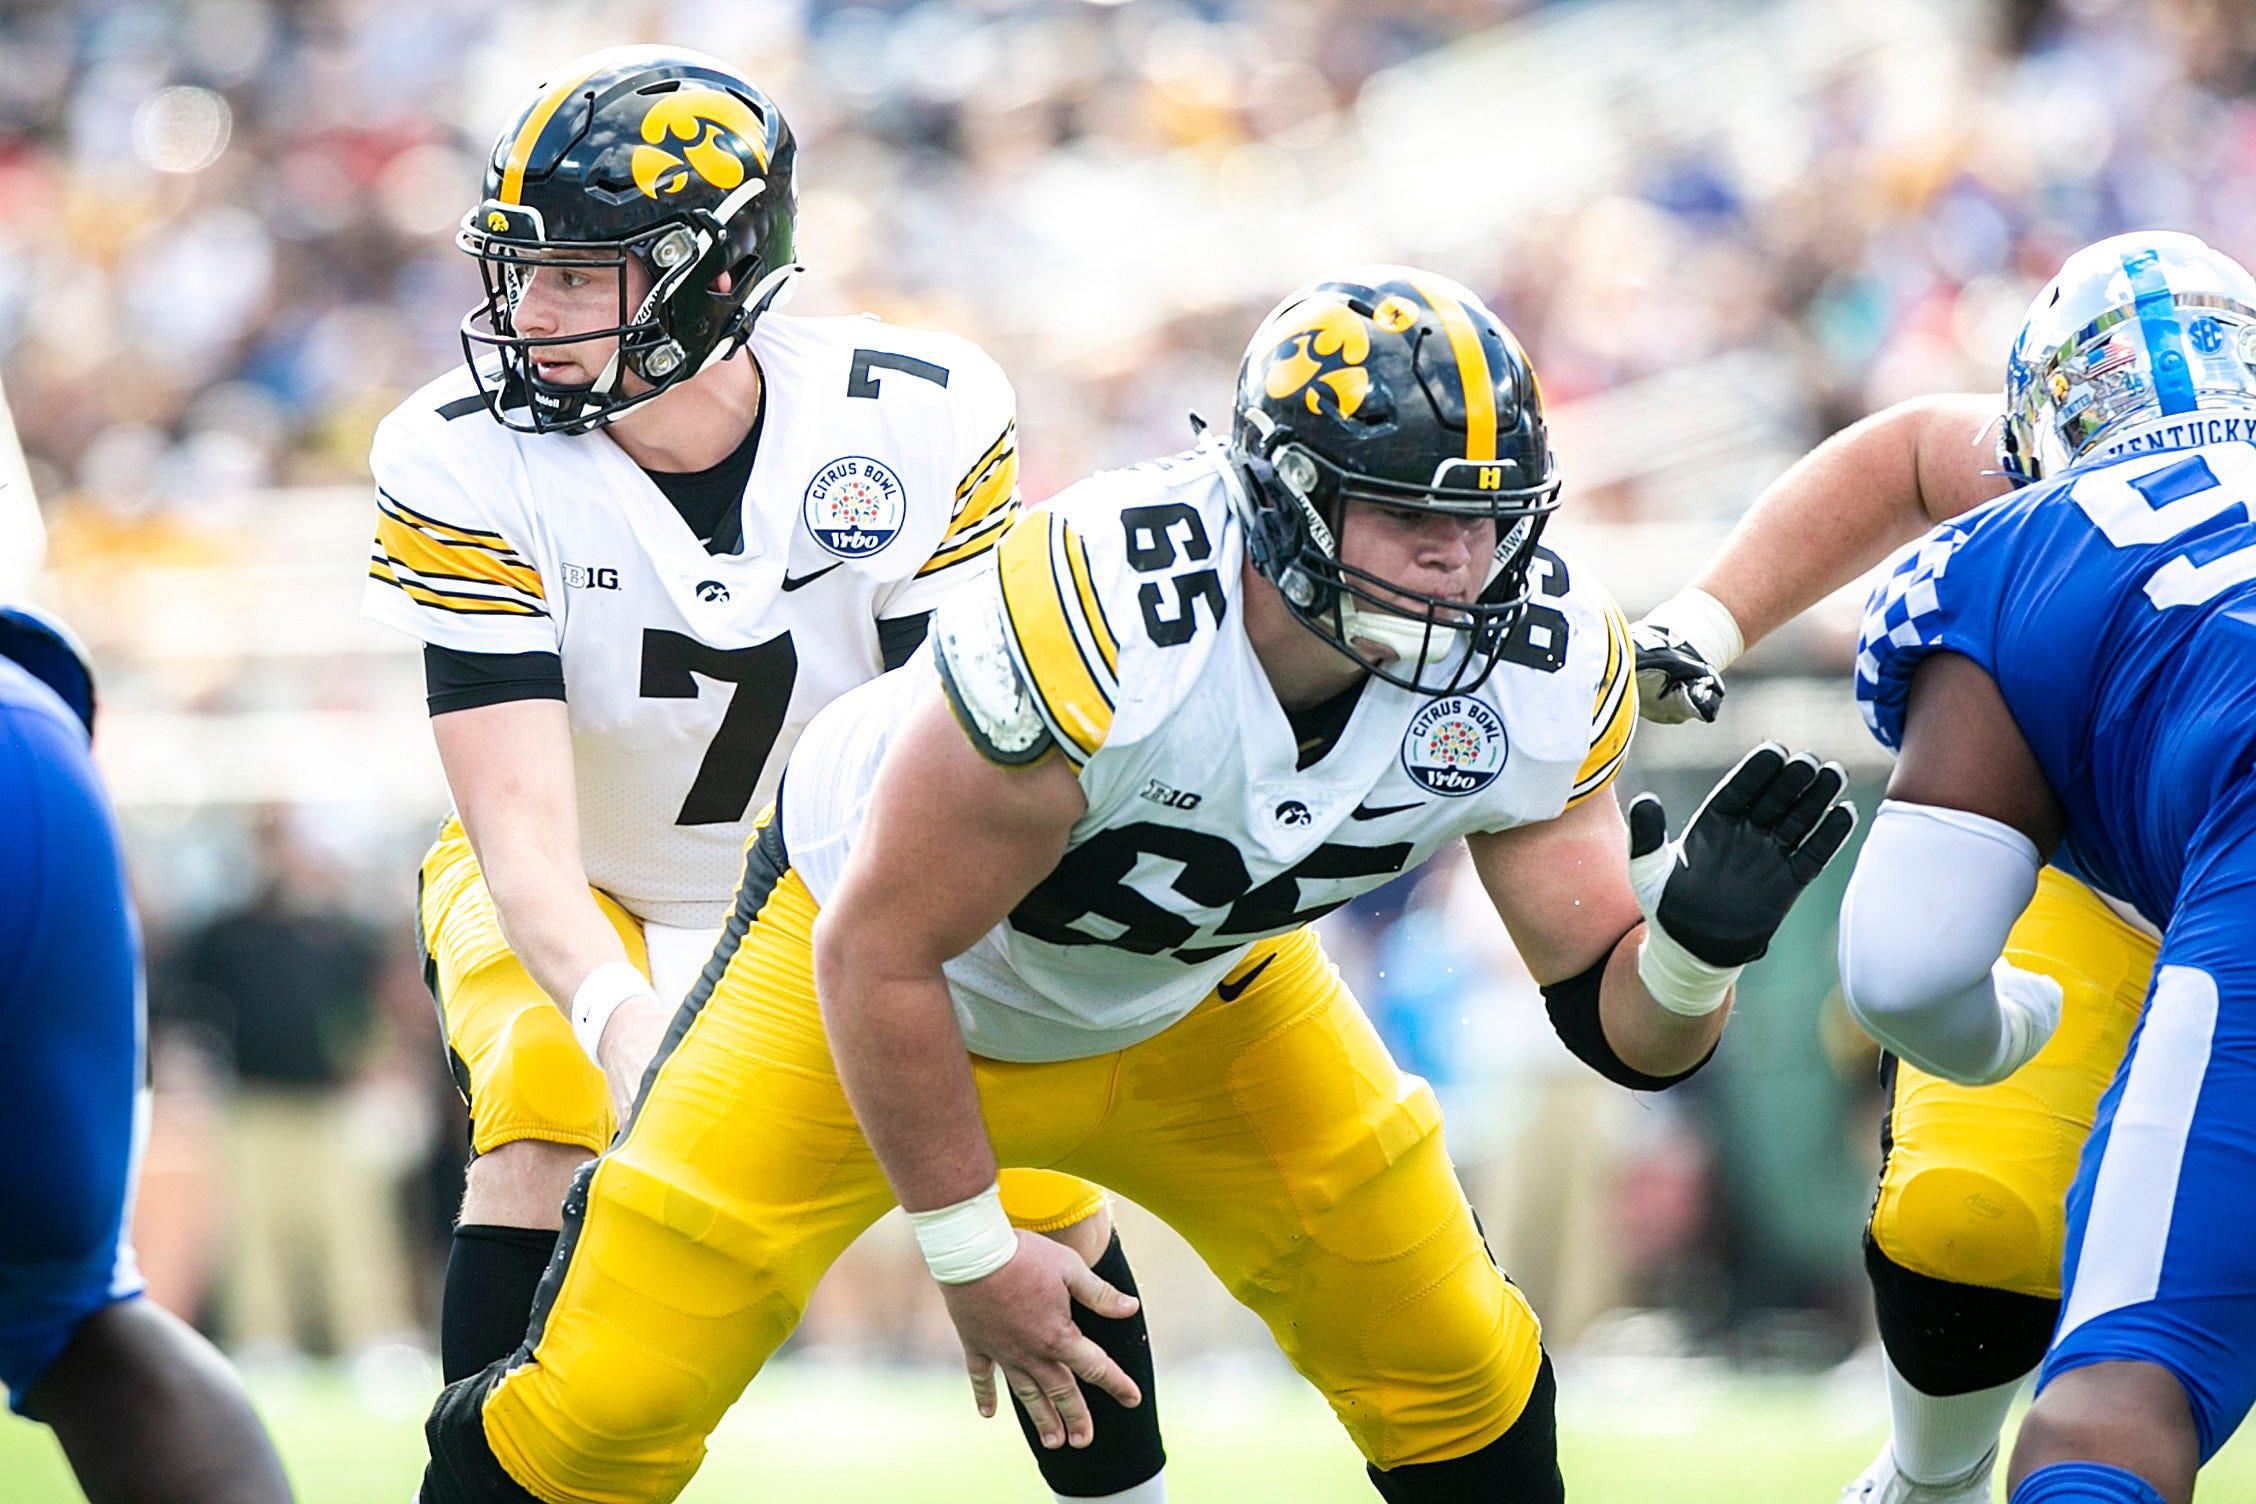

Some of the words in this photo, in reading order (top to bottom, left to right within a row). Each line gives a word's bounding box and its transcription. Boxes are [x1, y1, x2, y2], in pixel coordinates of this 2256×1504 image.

[847, 348, 949, 399] 7
[813, 462, 857, 500] CITRUS
[864, 465, 896, 500] BOWL
[830, 531, 879, 549] Vrbo
[1120, 502, 1227, 648] 65
[639, 628, 799, 826] 7
[1413, 700, 1461, 738] CITRUS
[1468, 704, 1500, 743] BOWL
[1427, 770, 1476, 789] Vrbo
[1007, 821, 1414, 966] 65
